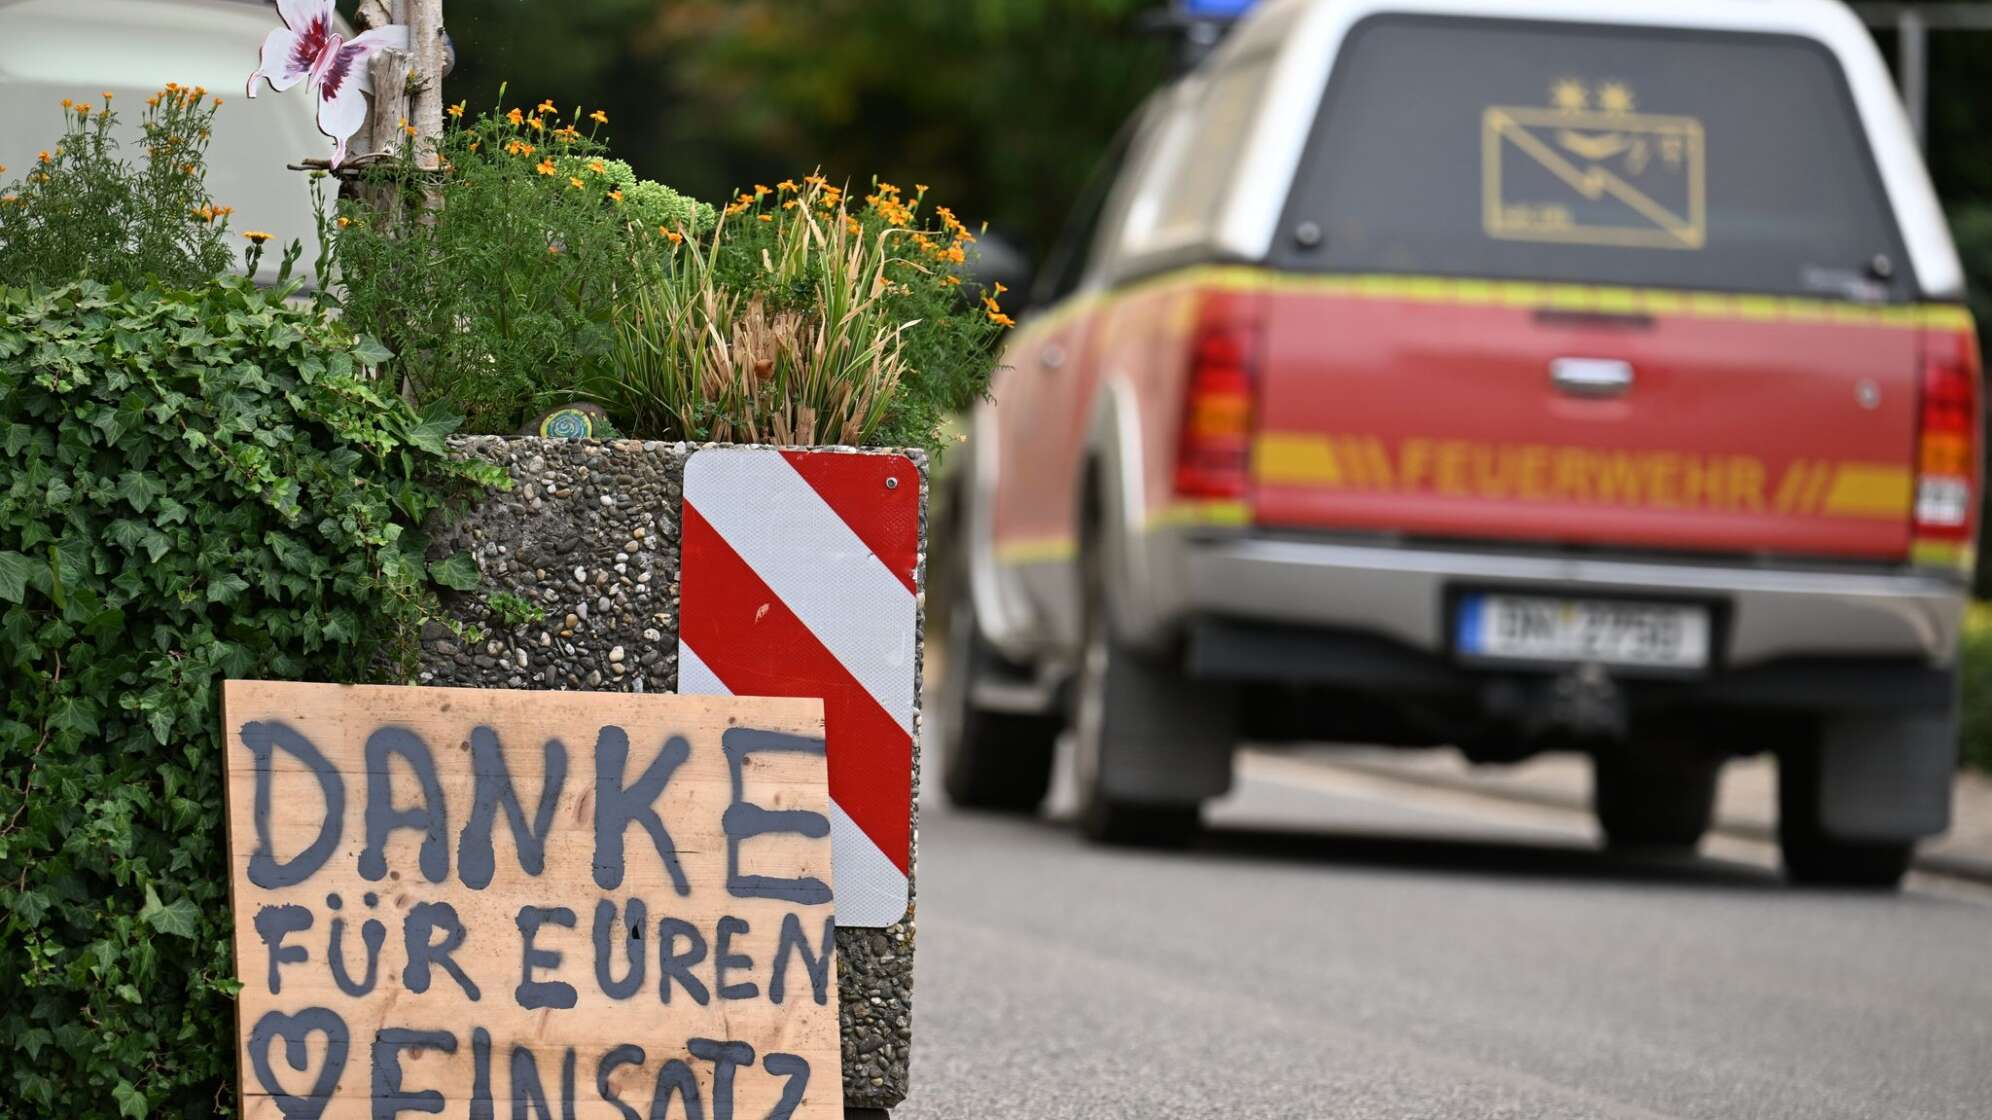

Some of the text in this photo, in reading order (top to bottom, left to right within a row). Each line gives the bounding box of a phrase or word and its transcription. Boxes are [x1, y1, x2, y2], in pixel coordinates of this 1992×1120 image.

[1402, 439, 1767, 511] FEUERWEHR
[240, 719, 834, 904] DANKE
[254, 891, 835, 1010] FÜR EUREN
[371, 1026, 811, 1120] EINSATZ
